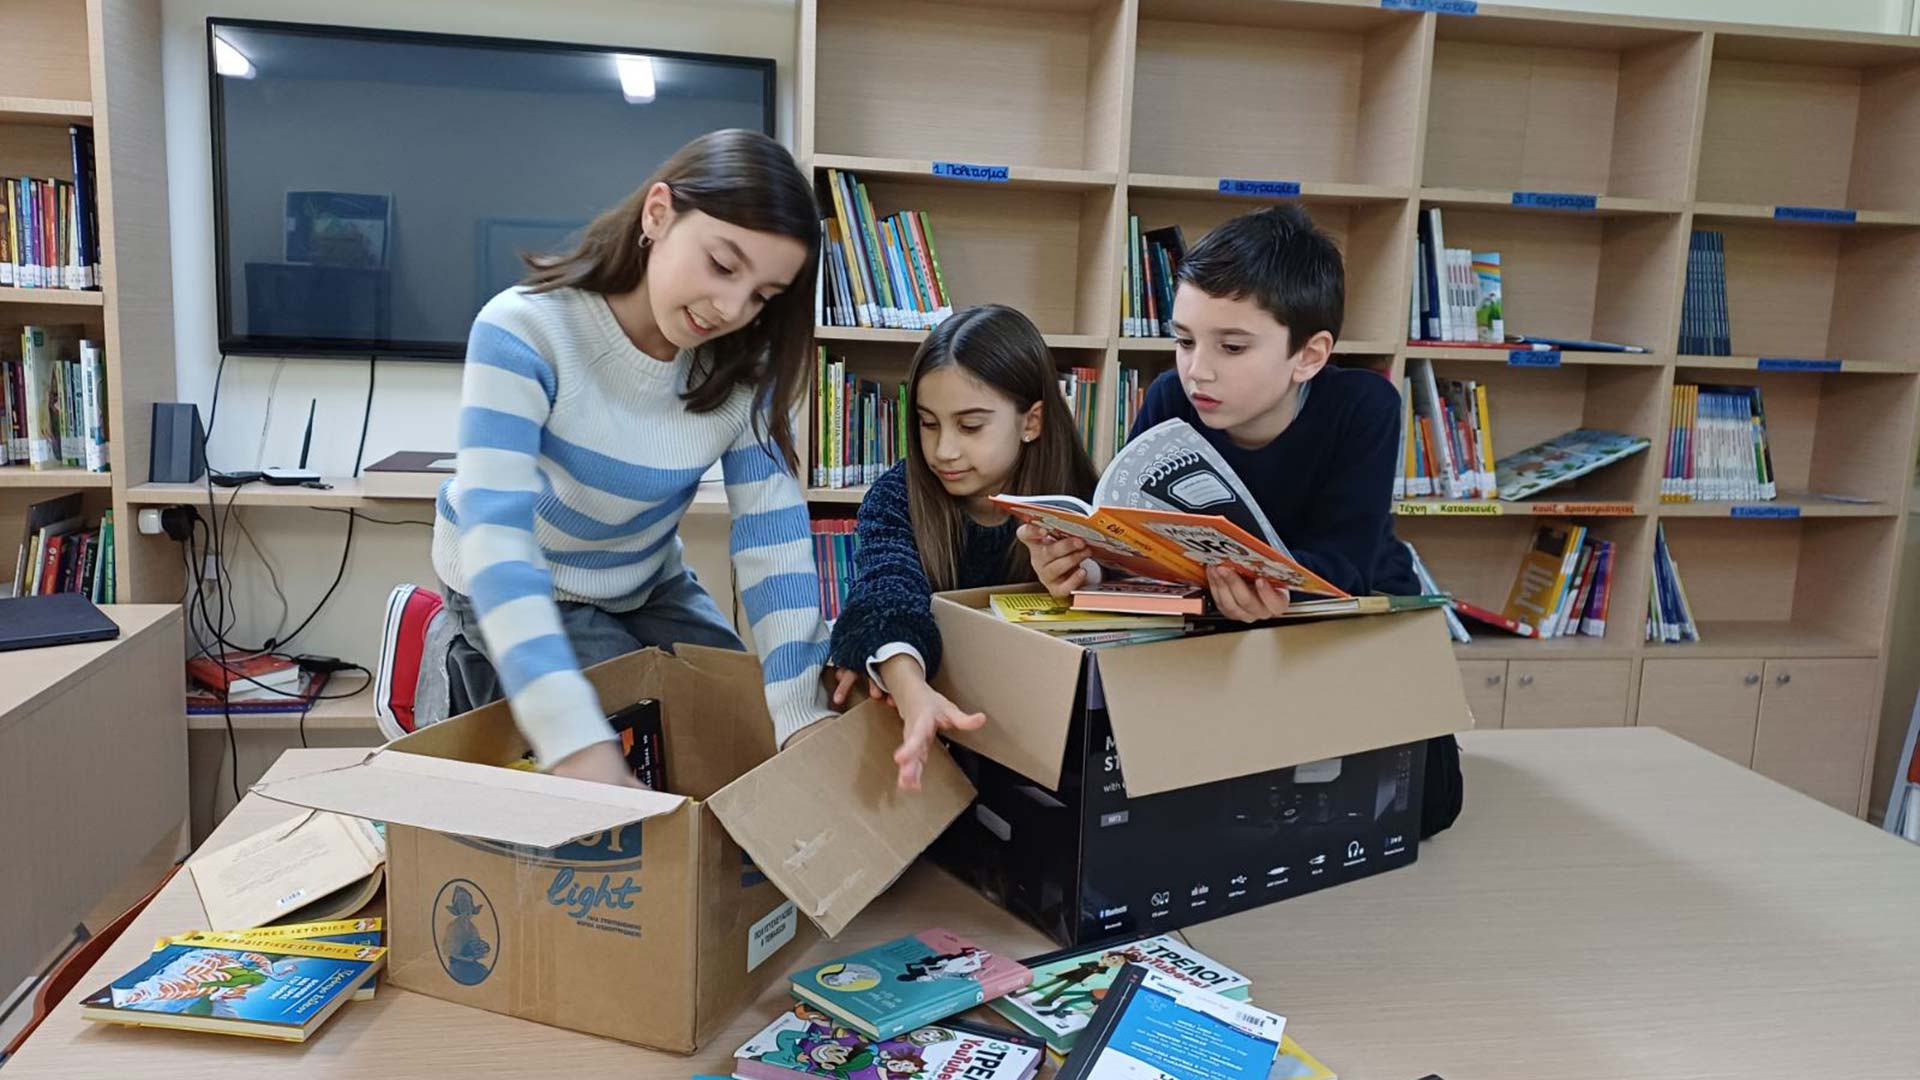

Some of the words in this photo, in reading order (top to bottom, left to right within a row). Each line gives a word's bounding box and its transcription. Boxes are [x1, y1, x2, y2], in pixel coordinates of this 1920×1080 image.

[1399, 503, 1427, 515] Τέχνη
[1440, 503, 1498, 515] Κατασκευές
[1183, 537, 1249, 556] UFO
[547, 866, 642, 918] light
[1146, 944, 1230, 986] ΤΡΕΛΟΙ
[961, 1050, 1008, 1080] ΤΡΕ
